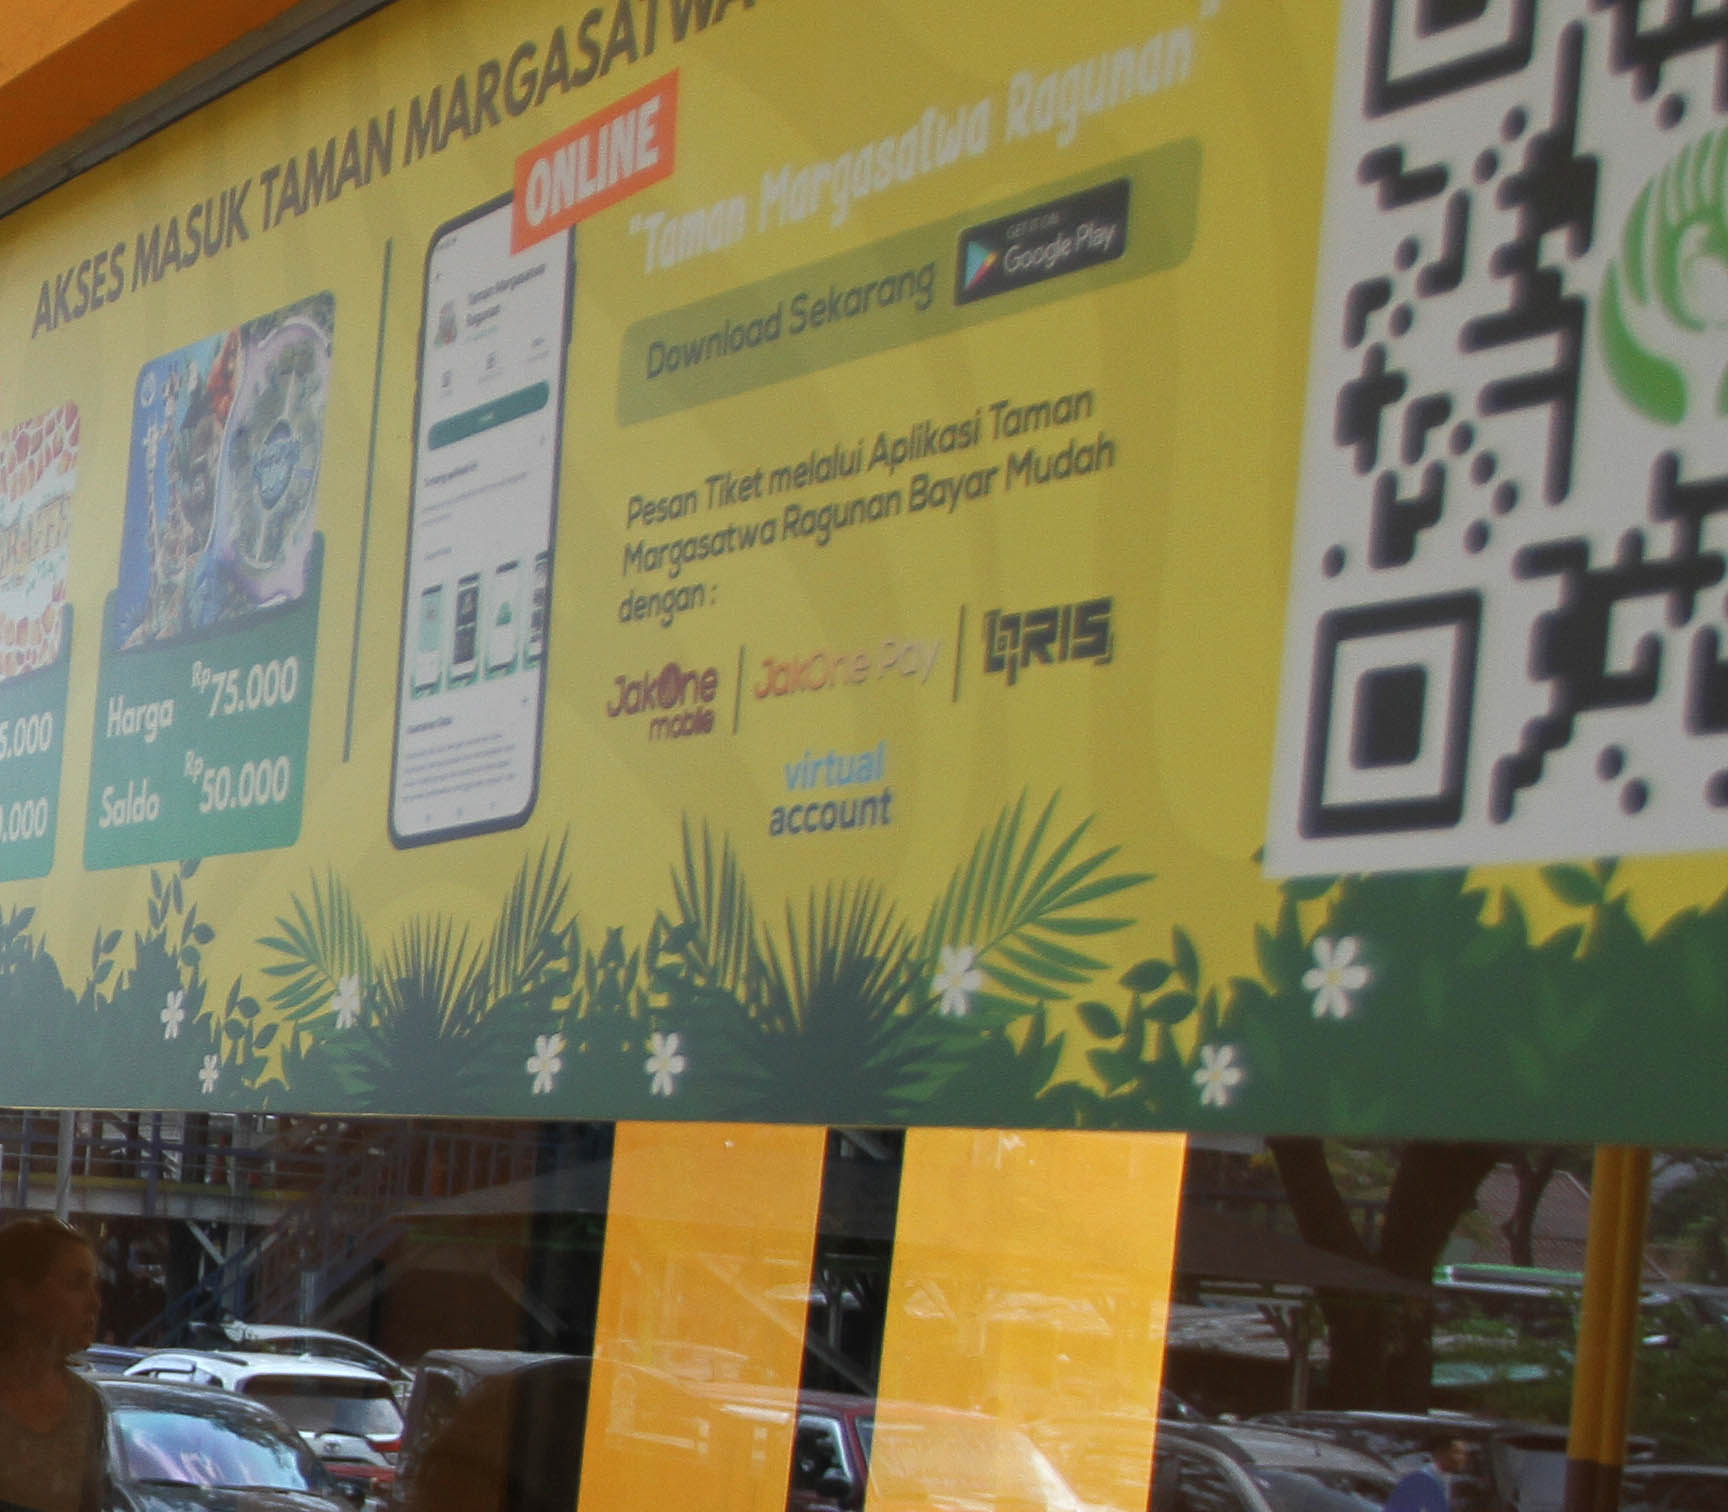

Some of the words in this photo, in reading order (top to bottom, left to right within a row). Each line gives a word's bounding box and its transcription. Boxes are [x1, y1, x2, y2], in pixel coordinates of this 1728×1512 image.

[524, 94, 662, 229] ONLINE
[757, 95, 992, 233] Margasatwa
[31, 241, 125, 341] AKSES
[131, 178, 251, 294] MASUK
[260, 107, 397, 232] TAMAN
[1003, 232, 1073, 274] Google
[1075, 220, 1119, 255] Play
[645, 305, 783, 380] Download
[788, 261, 937, 337] Sekarang
[626, 487, 697, 529] Pesan
[705, 464, 766, 511] Tiket
[769, 439, 864, 497] melalui
[867, 409, 982, 478] Aplikasi
[989, 389, 1095, 442] Taman
[622, 517, 778, 579] Margasatwa
[782, 489, 901, 547] Ragunan
[908, 462, 999, 515] Bayar
[1005, 432, 1117, 492] Mudah
[618, 580, 706, 628] dengan
[754, 648, 871, 700] JakOne
[877, 637, 942, 686] Pay
[983, 596, 1114, 687] QRIS
[107, 697, 175, 743] Harga
[607, 661, 718, 719] JakOne
[649, 708, 715, 742] mobile
[784, 739, 888, 792] virtual
[99, 778, 160, 829] Saldo
[769, 786, 895, 838] account
